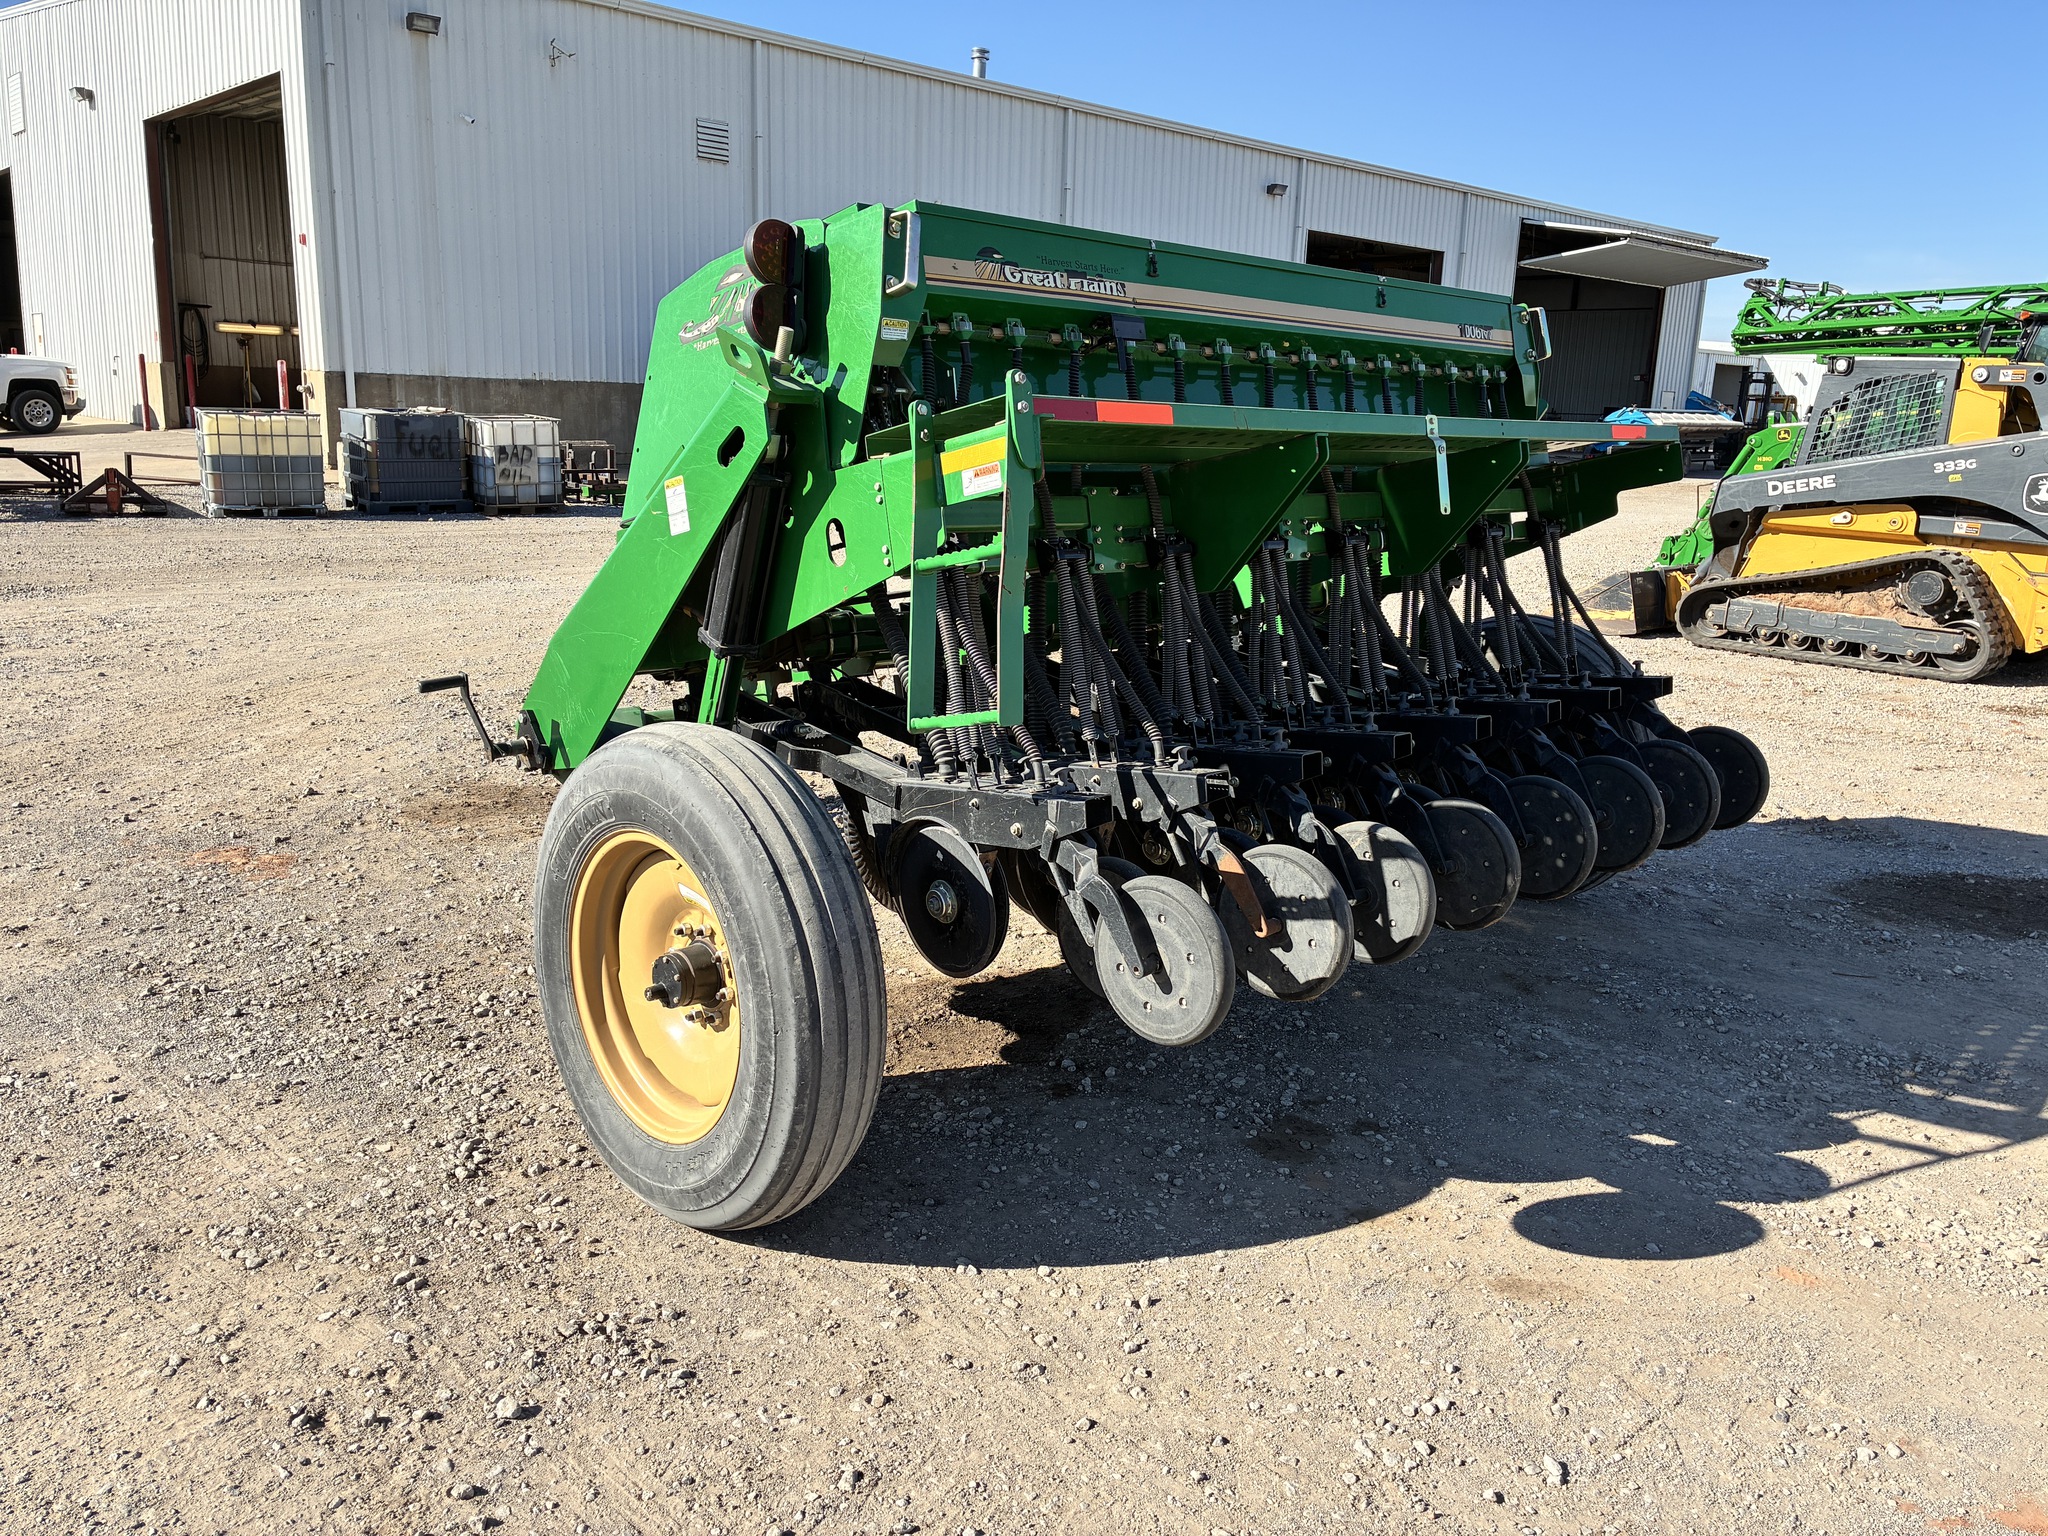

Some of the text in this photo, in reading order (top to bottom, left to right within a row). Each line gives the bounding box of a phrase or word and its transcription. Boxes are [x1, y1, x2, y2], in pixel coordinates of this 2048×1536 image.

[1003, 264, 1066, 289] Great
[1075, 260, 1098, 272] Starts
[394, 418, 454, 459] Fuel
[497, 445, 533, 466] BAD
[1933, 458, 1977, 474] 333G
[1766, 474, 1836, 497] DEERE
